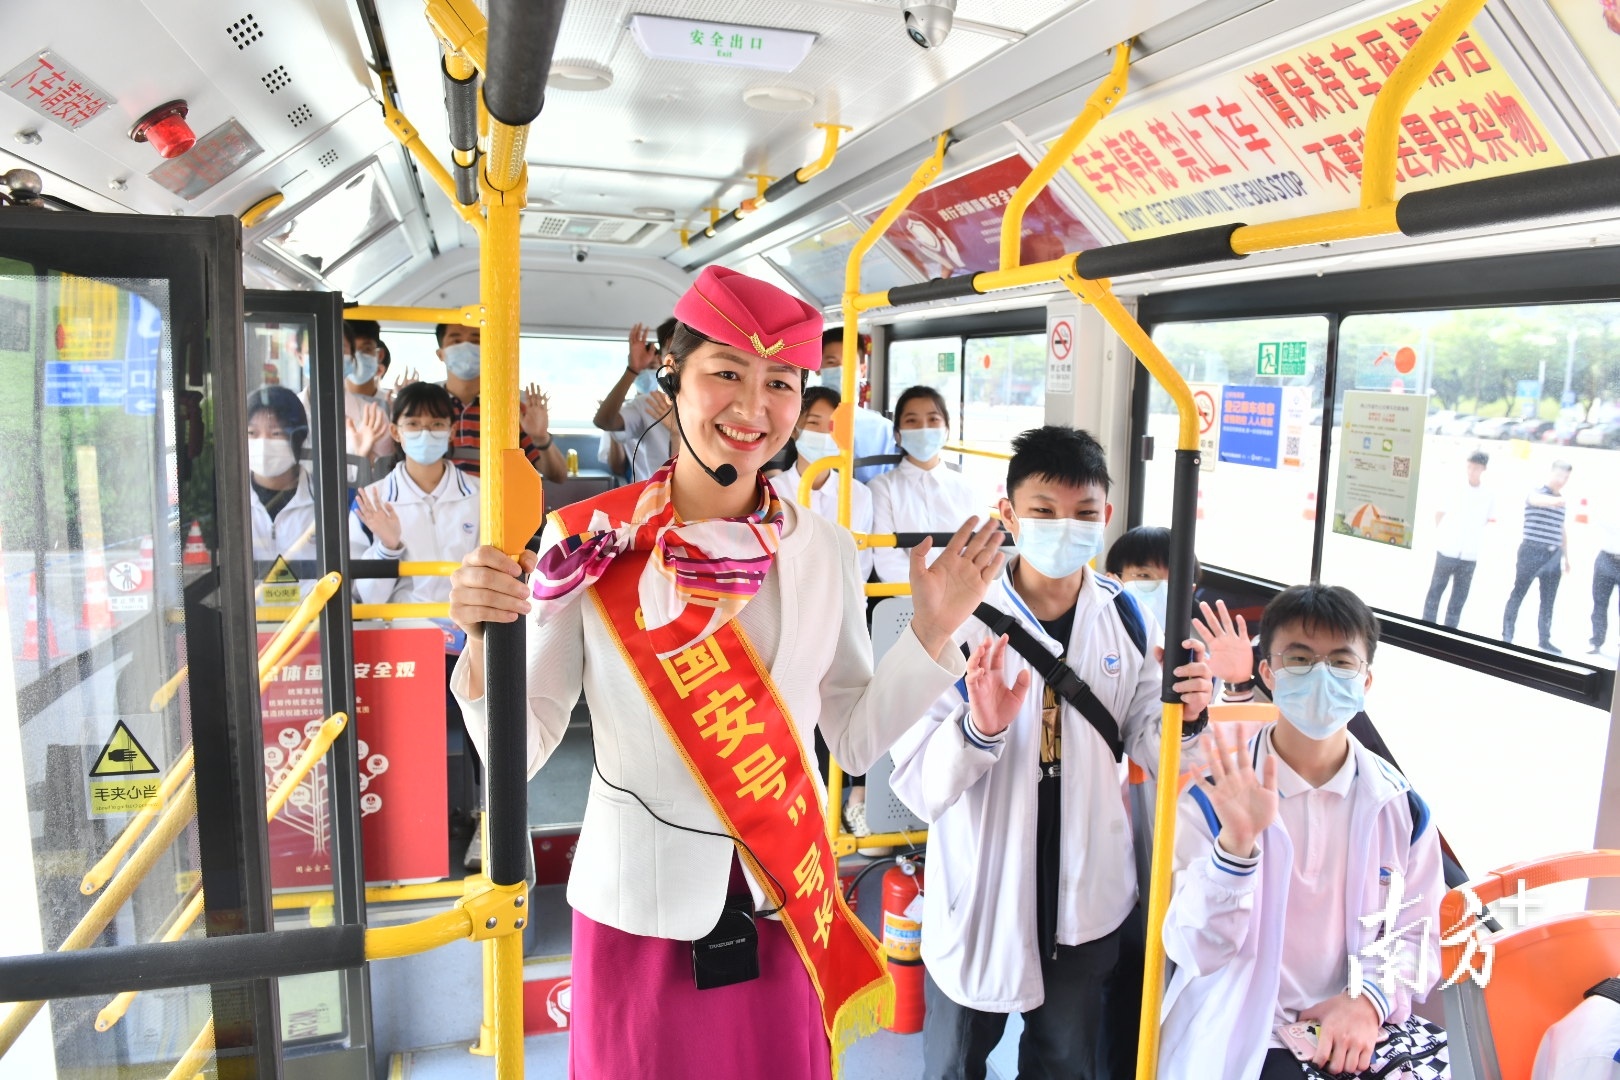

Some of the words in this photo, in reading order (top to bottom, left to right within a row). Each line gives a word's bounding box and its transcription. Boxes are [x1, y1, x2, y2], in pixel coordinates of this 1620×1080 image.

[690, 29, 763, 50] 安全出口
[717, 50, 732, 58] Exit
[1072, 130, 1179, 205] 车未停稳
[1145, 96, 1275, 184] 禁止下车
[1118, 207, 1153, 232] DON'T
[1146, 202, 1174, 226] GET
[1165, 194, 1203, 221] DOWN
[1194, 186, 1234, 216] UNTIL
[1220, 181, 1256, 209] THE
[1242, 176, 1276, 206] BUS
[1266, 171, 1307, 203] STOP
[266, 661, 416, 682] 体国安全观
